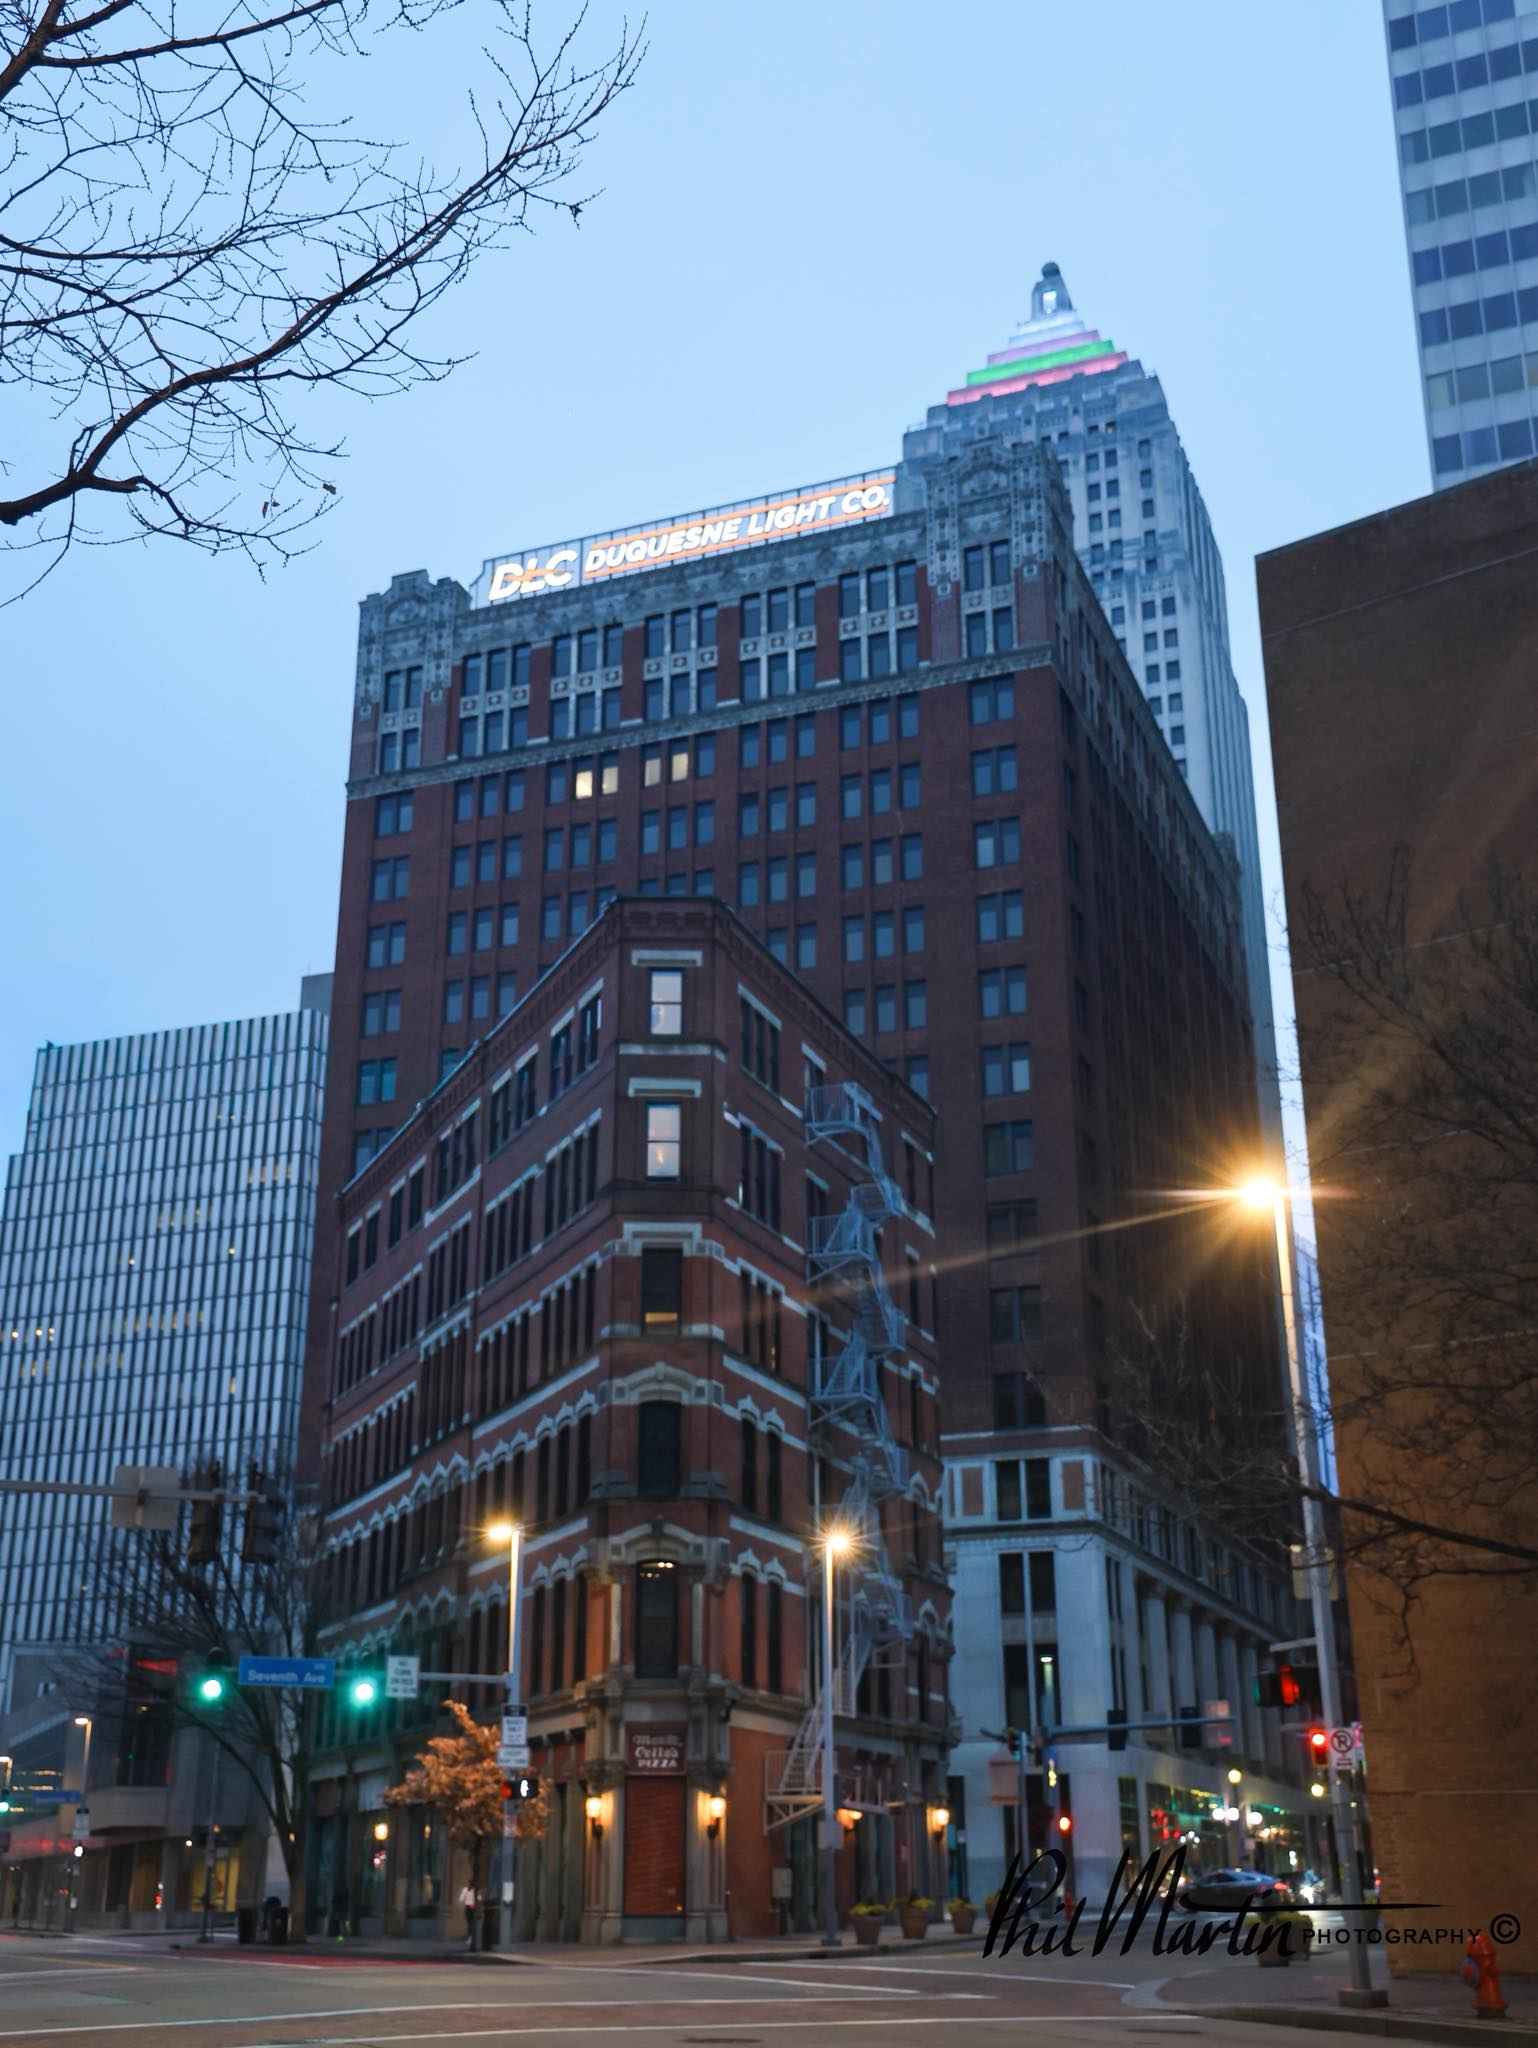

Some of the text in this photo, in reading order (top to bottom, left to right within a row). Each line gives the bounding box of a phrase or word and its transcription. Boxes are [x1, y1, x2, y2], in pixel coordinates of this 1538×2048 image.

[584, 484, 891, 573] DUQUESNE LIGHT CO.
[487, 550, 579, 601] DLC
[247, 1669, 326, 1684] Seventh Ave
[637, 1758, 678, 1769] PIZZA
